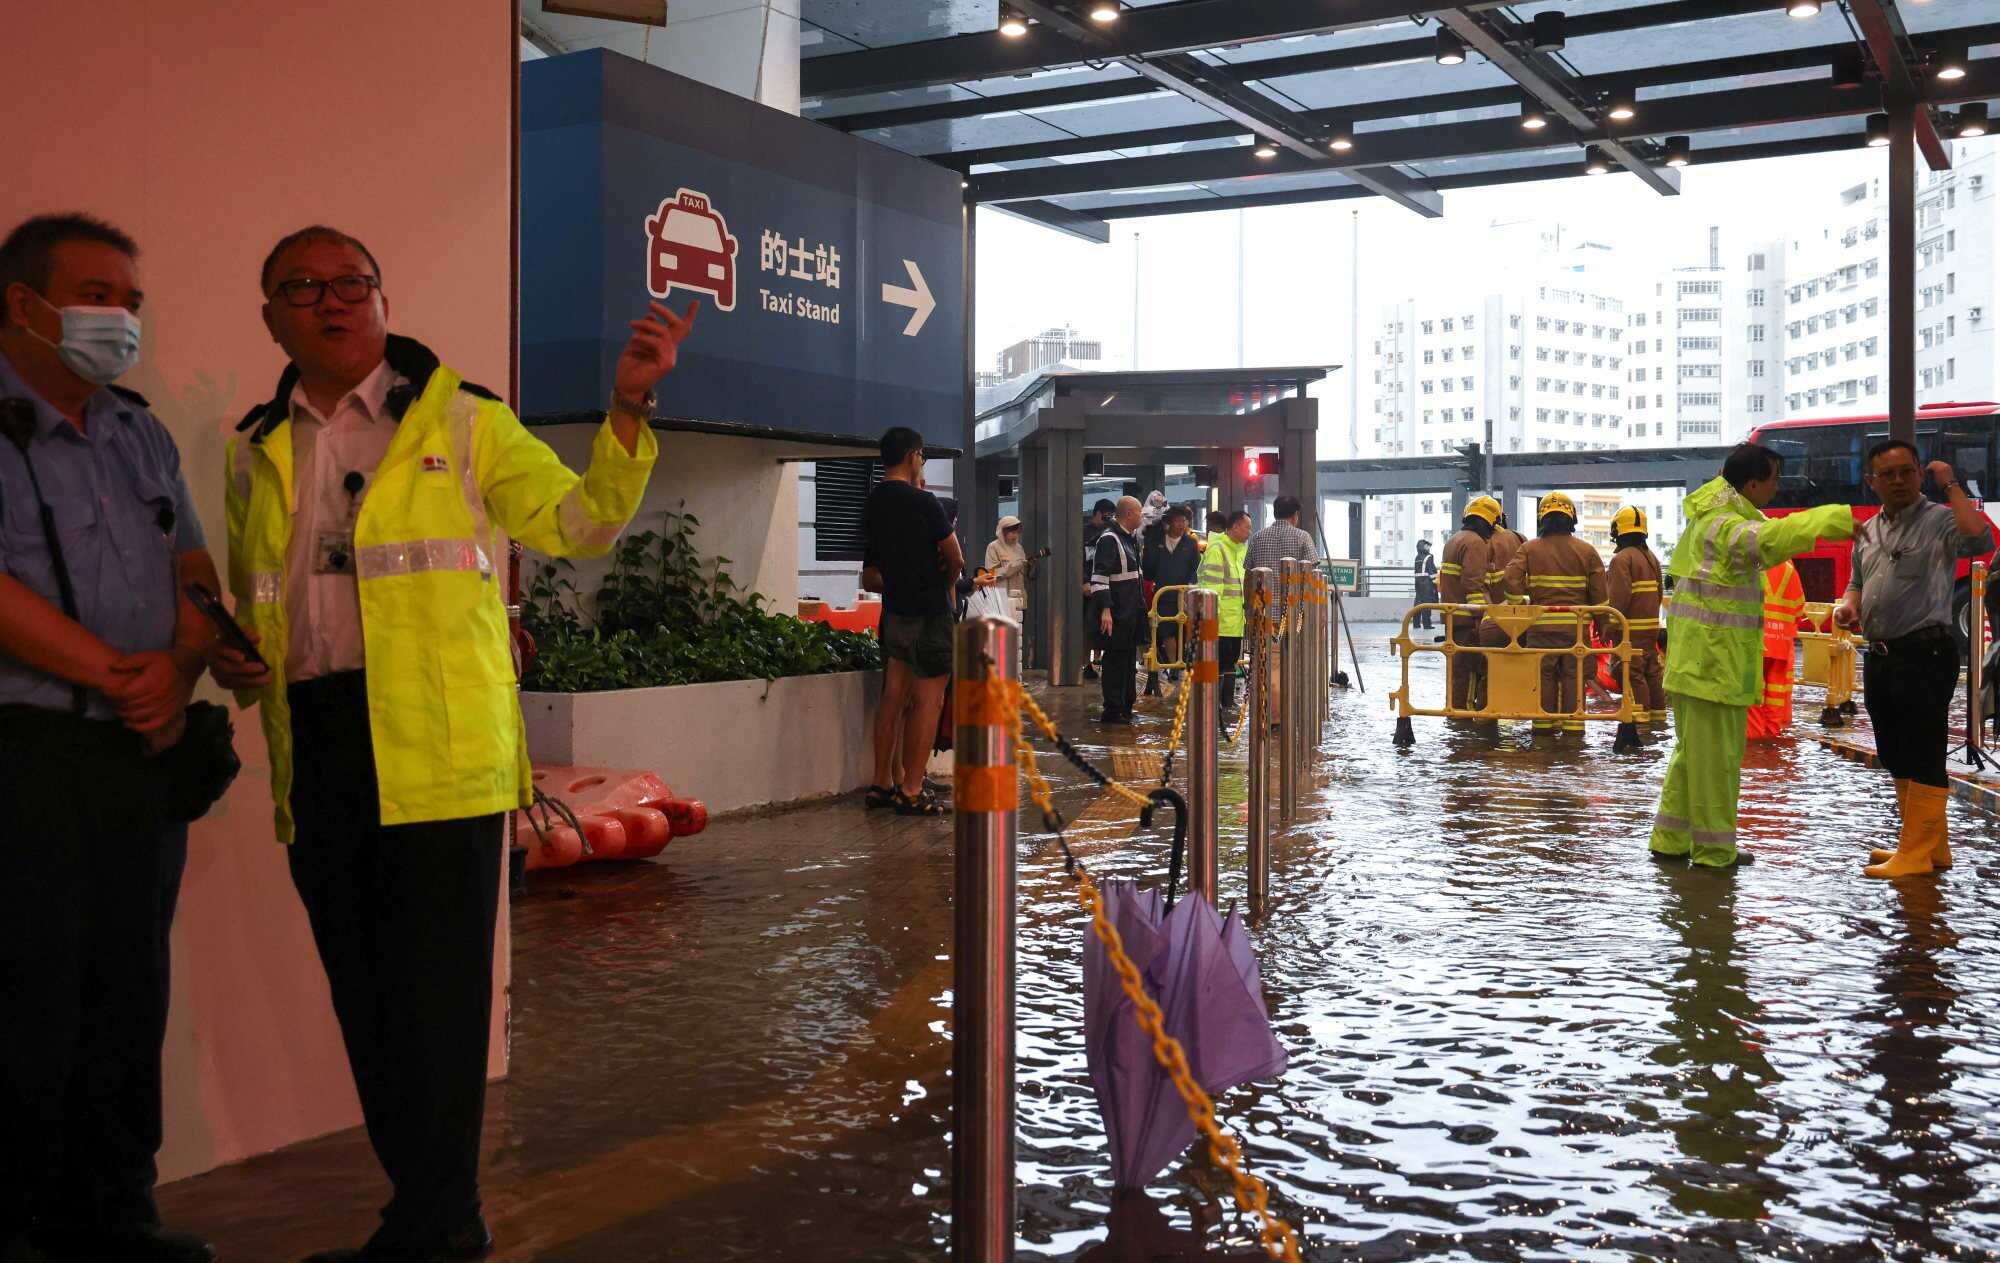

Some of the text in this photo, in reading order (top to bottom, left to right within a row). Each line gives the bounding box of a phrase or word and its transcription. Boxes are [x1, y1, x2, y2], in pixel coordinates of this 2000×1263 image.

[682, 196, 704, 210] TAXI
[760, 228, 841, 289] 的士站
[759, 288, 840, 325] Taxi Stand
